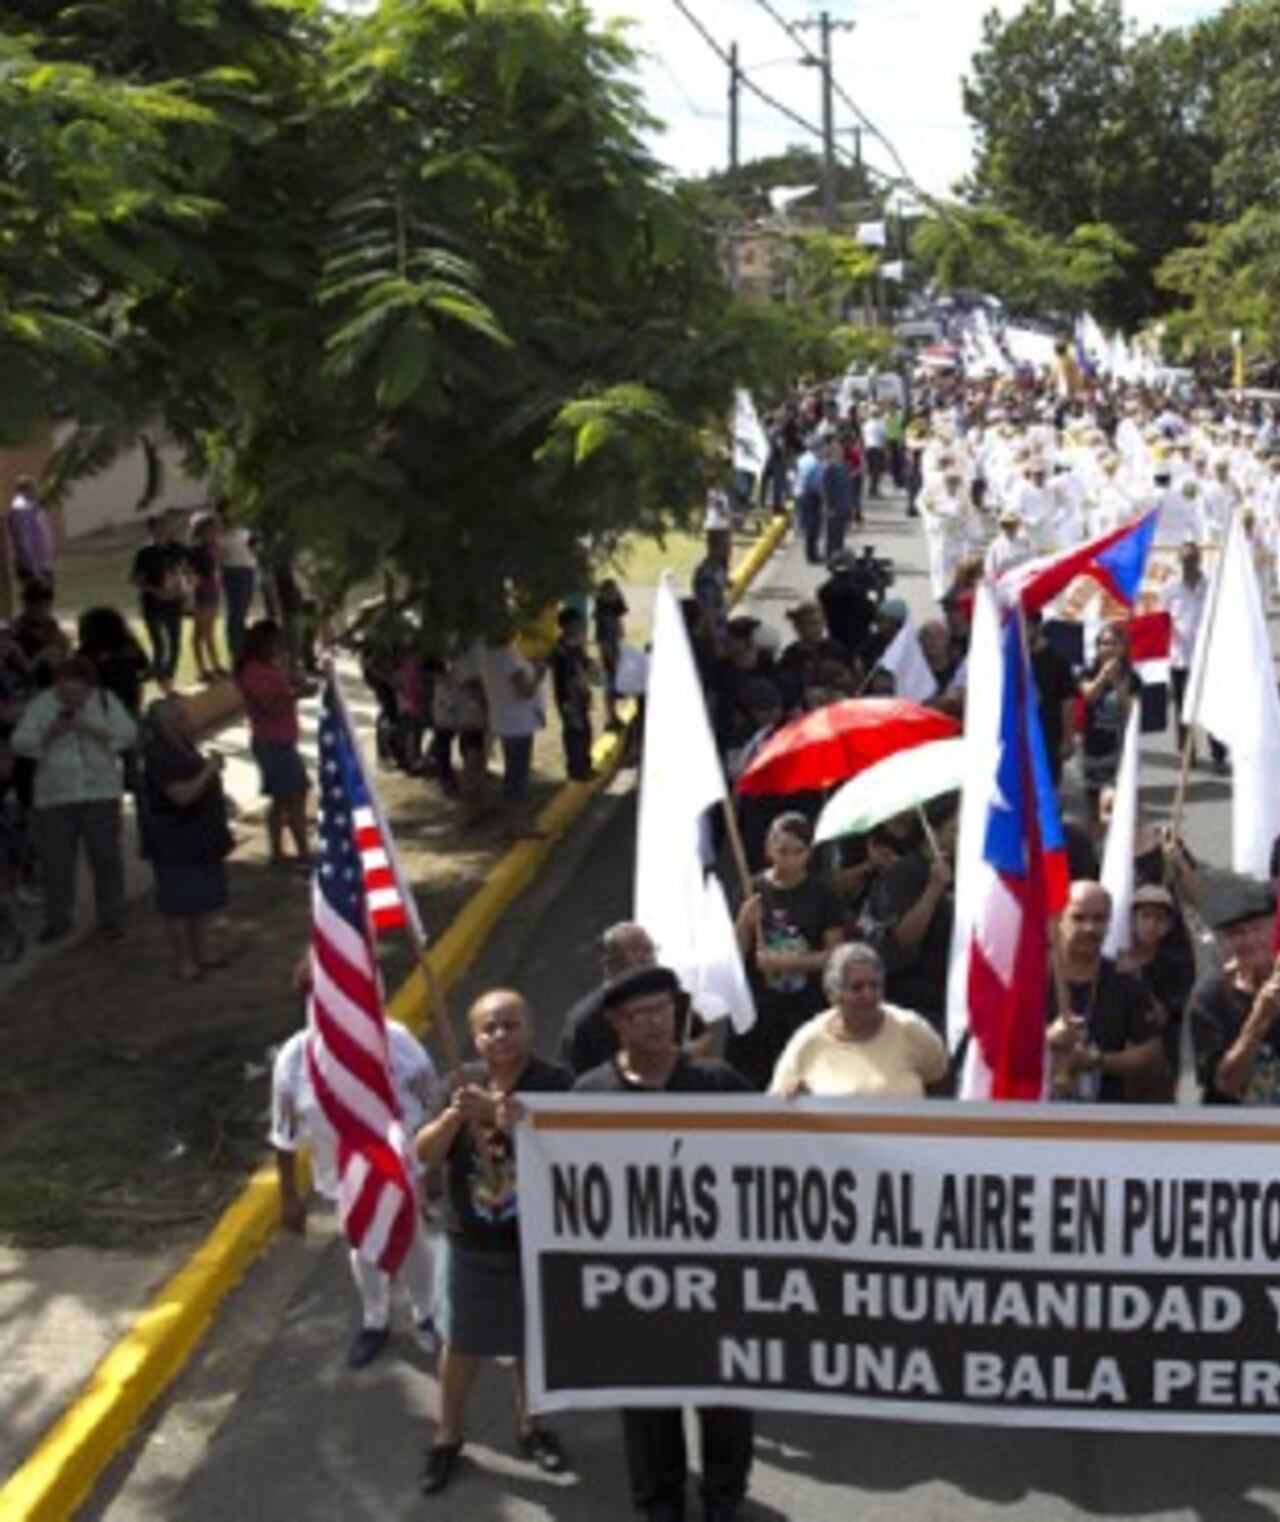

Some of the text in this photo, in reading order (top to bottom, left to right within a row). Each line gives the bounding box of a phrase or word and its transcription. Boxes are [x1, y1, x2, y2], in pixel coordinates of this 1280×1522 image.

[551, 1162, 611, 1240] NO
[624, 1138, 719, 1243] MÁS
[732, 1166, 857, 1245] TIROS
[870, 1172, 923, 1248] AL
[934, 1174, 1036, 1254] AIRE
[1050, 1178, 1106, 1255] EN
[581, 1266, 716, 1311] POR
[743, 1268, 817, 1313] LA
[843, 1272, 1244, 1333] HUMANIDAD
[719, 1336, 784, 1382] NI
[810, 1341, 940, 1394] UNA
[964, 1352, 1126, 1402] BALA
